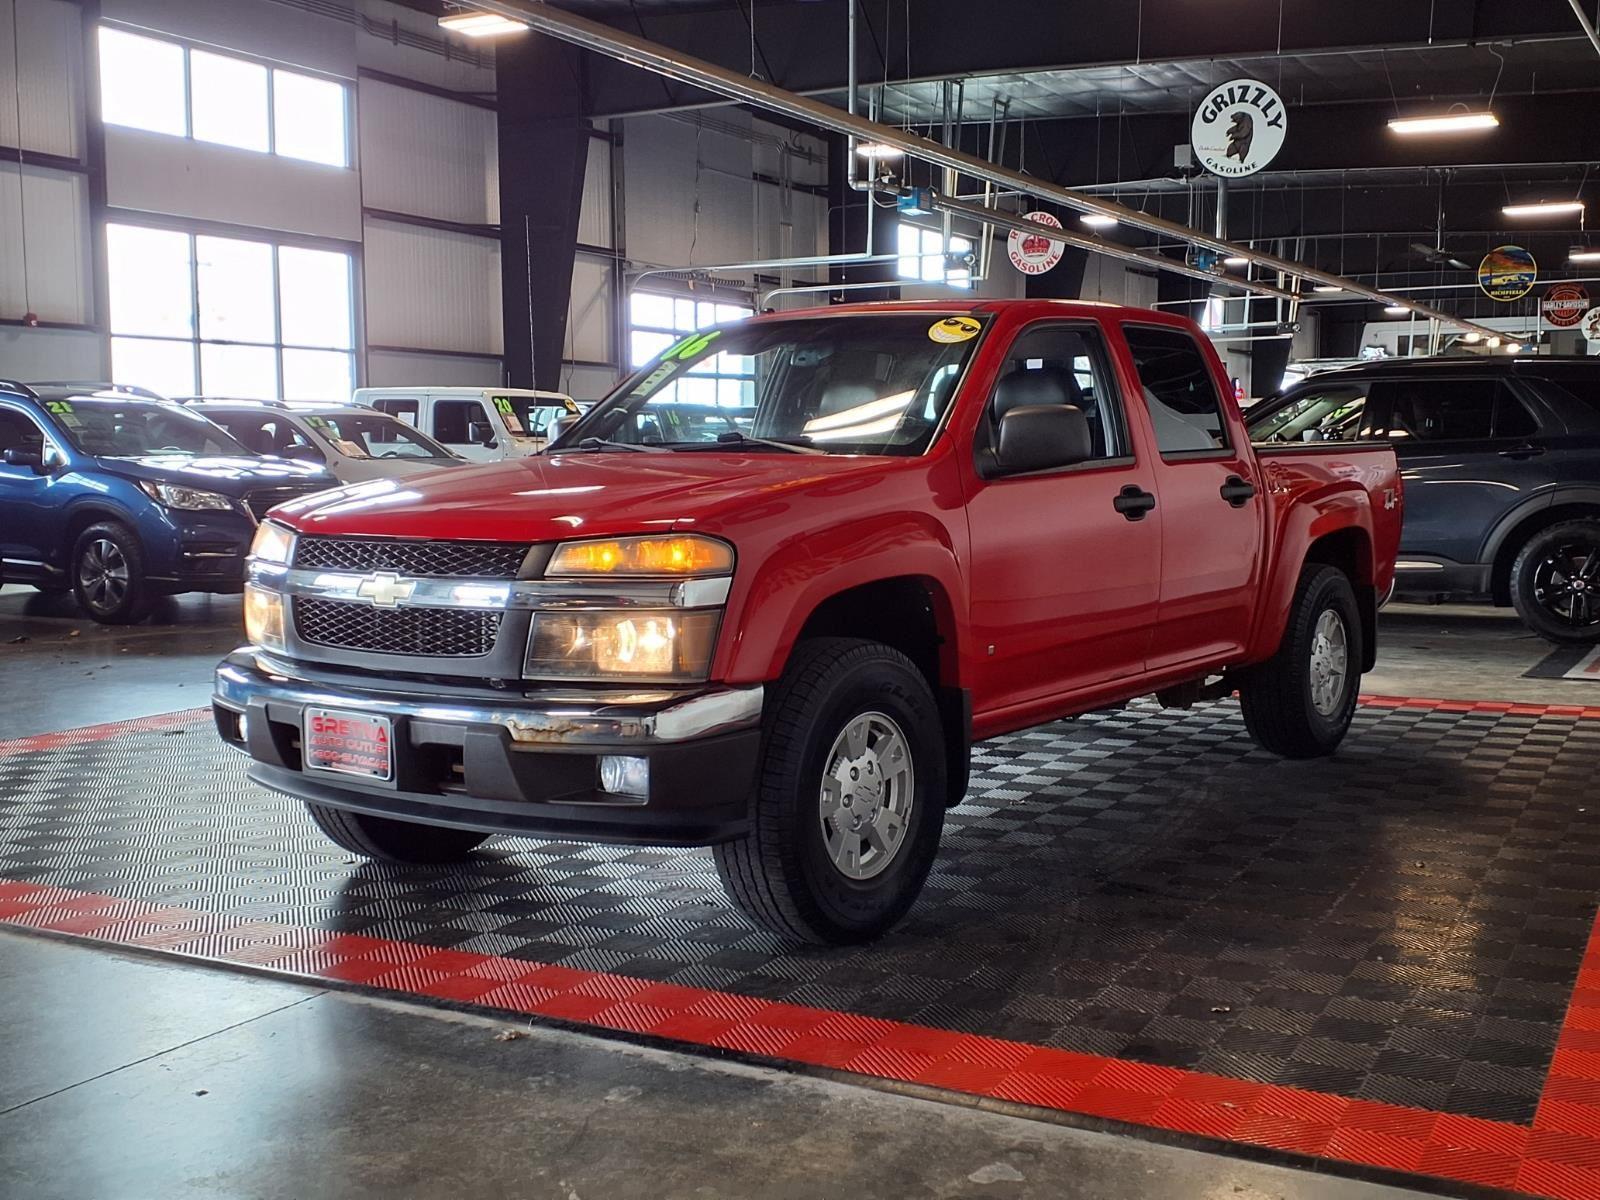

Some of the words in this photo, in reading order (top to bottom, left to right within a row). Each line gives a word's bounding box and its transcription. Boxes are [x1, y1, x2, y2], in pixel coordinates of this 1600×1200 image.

[1202, 85, 1282, 129] GRIZZLY
[1206, 157, 1257, 173] GASOLINE
[1010, 251, 1060, 272] GASOLINE
[46, 401, 73, 413] 21
[494, 398, 513, 414] 20
[312, 716, 387, 743] GRETNA
[310, 735, 345, 747] AUTO
